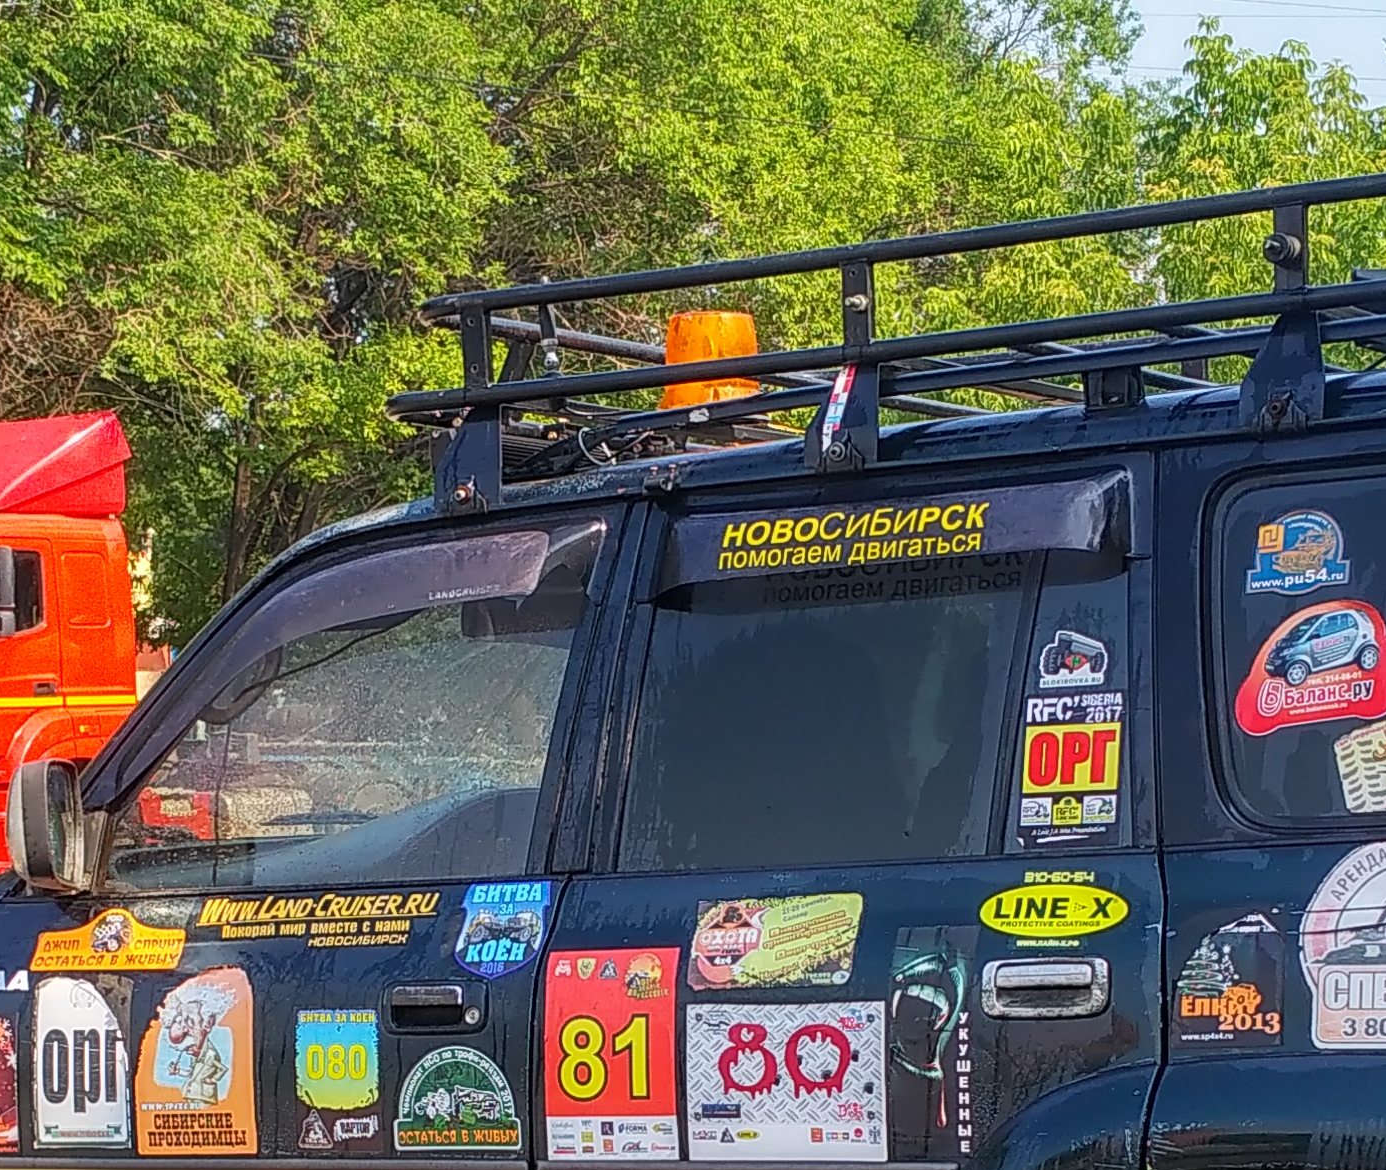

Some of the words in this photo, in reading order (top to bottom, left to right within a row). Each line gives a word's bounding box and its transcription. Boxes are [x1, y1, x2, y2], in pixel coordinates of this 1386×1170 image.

[718, 541, 841, 570] помогаем
[847, 531, 982, 565] двигаться
[1251, 567, 1344, 589] www.pu54.ru
[1284, 681, 1373, 706] Баланс.ру
[1085, 707, 1124, 723] 2017
[1028, 730, 1117, 787] ОРГ
[471, 883, 543, 903] БИТВА
[498, 903, 515, 915] ЗА
[783, 910, 808, 923] Салаир
[222, 923, 276, 938] Покоряй
[280, 922, 305, 936] мир
[311, 921, 358, 934] вместе
[363, 922, 370, 931] с
[375, 919, 410, 931] нами
[699, 929, 758, 945] ОХОТА
[43, 940, 80, 952] ДЖИП
[133, 939, 183, 950] СПРИНТ
[308, 934, 407, 947] НОВОСИБИРСК
[34, 955, 104, 967] ОСТАТЬСЯ
[109, 955, 118, 964] В
[123, 953, 179, 966] ЖИВЫХ
[465, 939, 526, 963] КОЁН
[714, 956, 732, 965] 4x4
[300, 1014, 332, 1022] БИТВА
[335, 1014, 347, 1022] ЗА
[1218, 1012, 1281, 1034] 2013
[1342, 1019, 1357, 1037] 3
[306, 1044, 368, 1081] 080
[558, 1013, 651, 1101] 81
[718, 1023, 851, 1099] 80
[424, 1054, 440, 1069] НСО
[500, 1090, 512, 1113] 2017
[956, 1011, 973, 1154] УКУШЕННЫЕ
[154, 1113, 233, 1130] СИБИРСКИЕ
[148, 1130, 247, 1149] ПРОХОДИМЦЫ
[398, 1129, 458, 1144] ОСТАТЬСЯ
[462, 1130, 470, 1142] В
[474, 1128, 519, 1143] ЖИВЫХ
